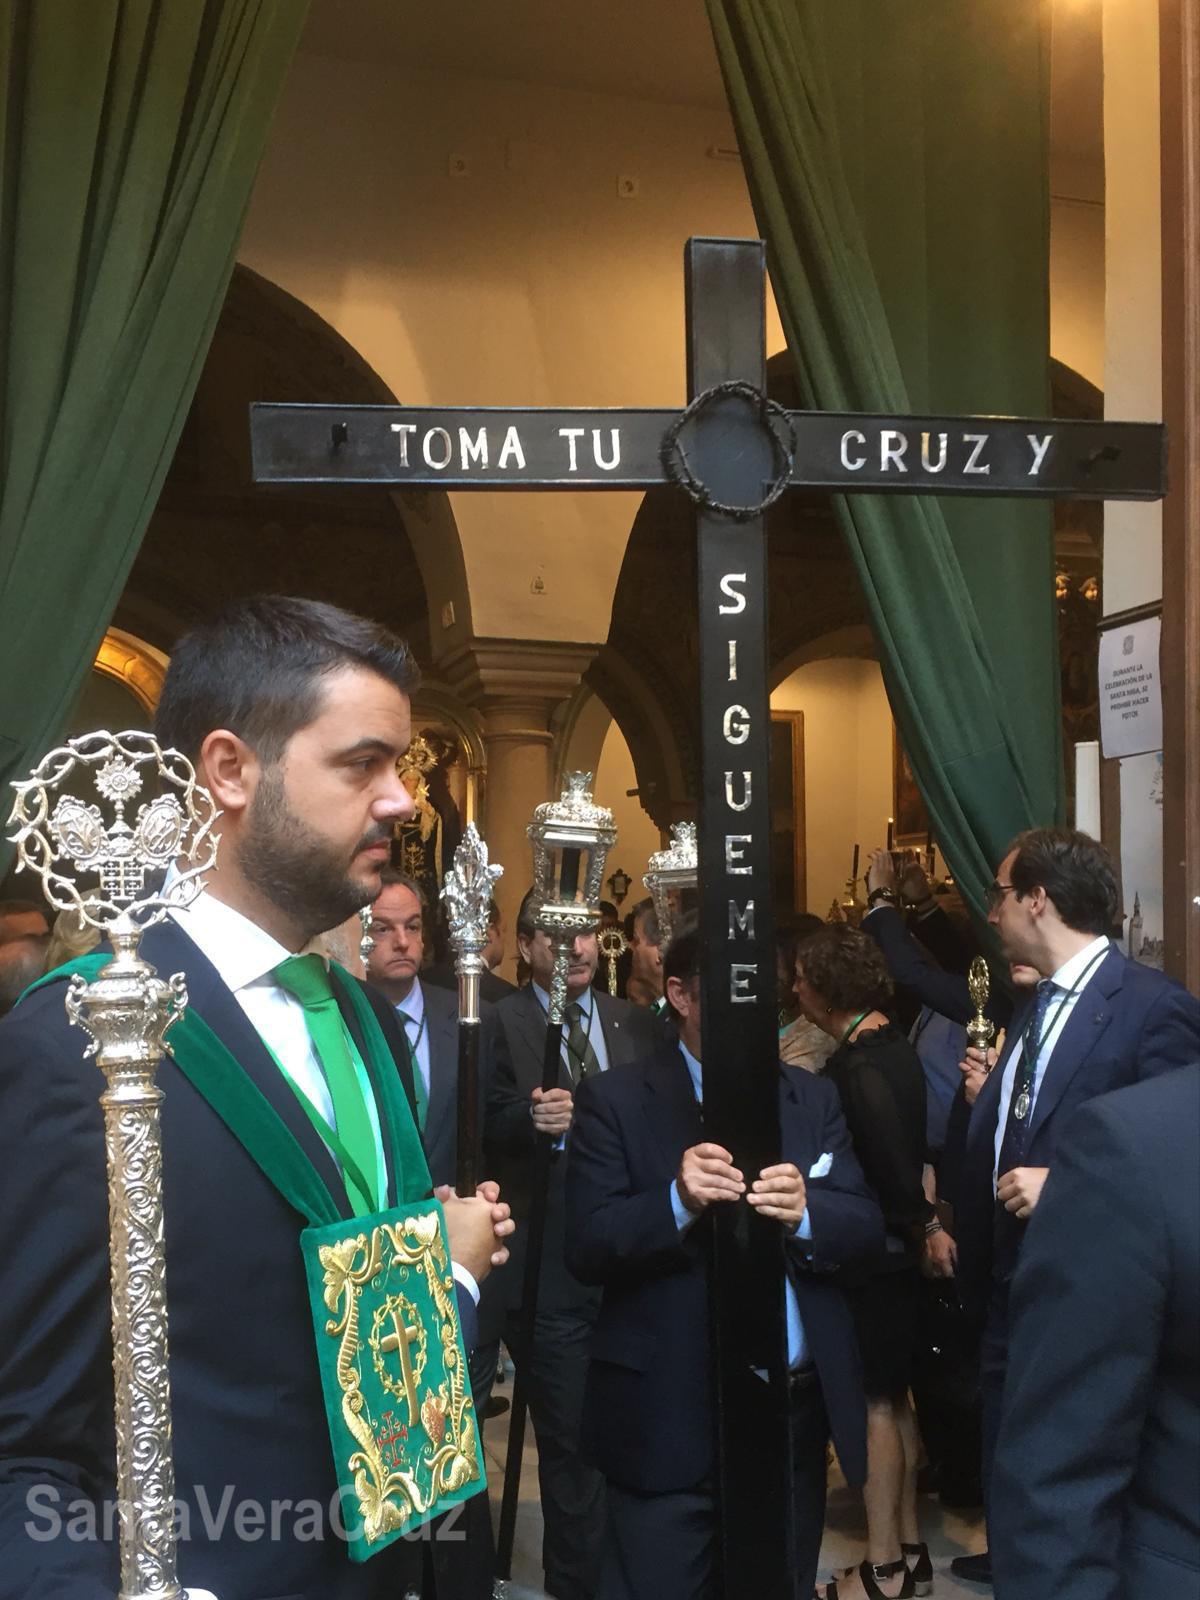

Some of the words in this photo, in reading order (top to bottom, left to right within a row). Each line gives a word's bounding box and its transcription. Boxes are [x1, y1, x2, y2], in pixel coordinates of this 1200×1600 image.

[391, 424, 526, 470] TOMA
[558, 428, 621, 471] TU
[840, 430, 990, 475] CRUZ
[1027, 434, 1053, 475] Y
[718, 573, 758, 1003] SIGUEME
